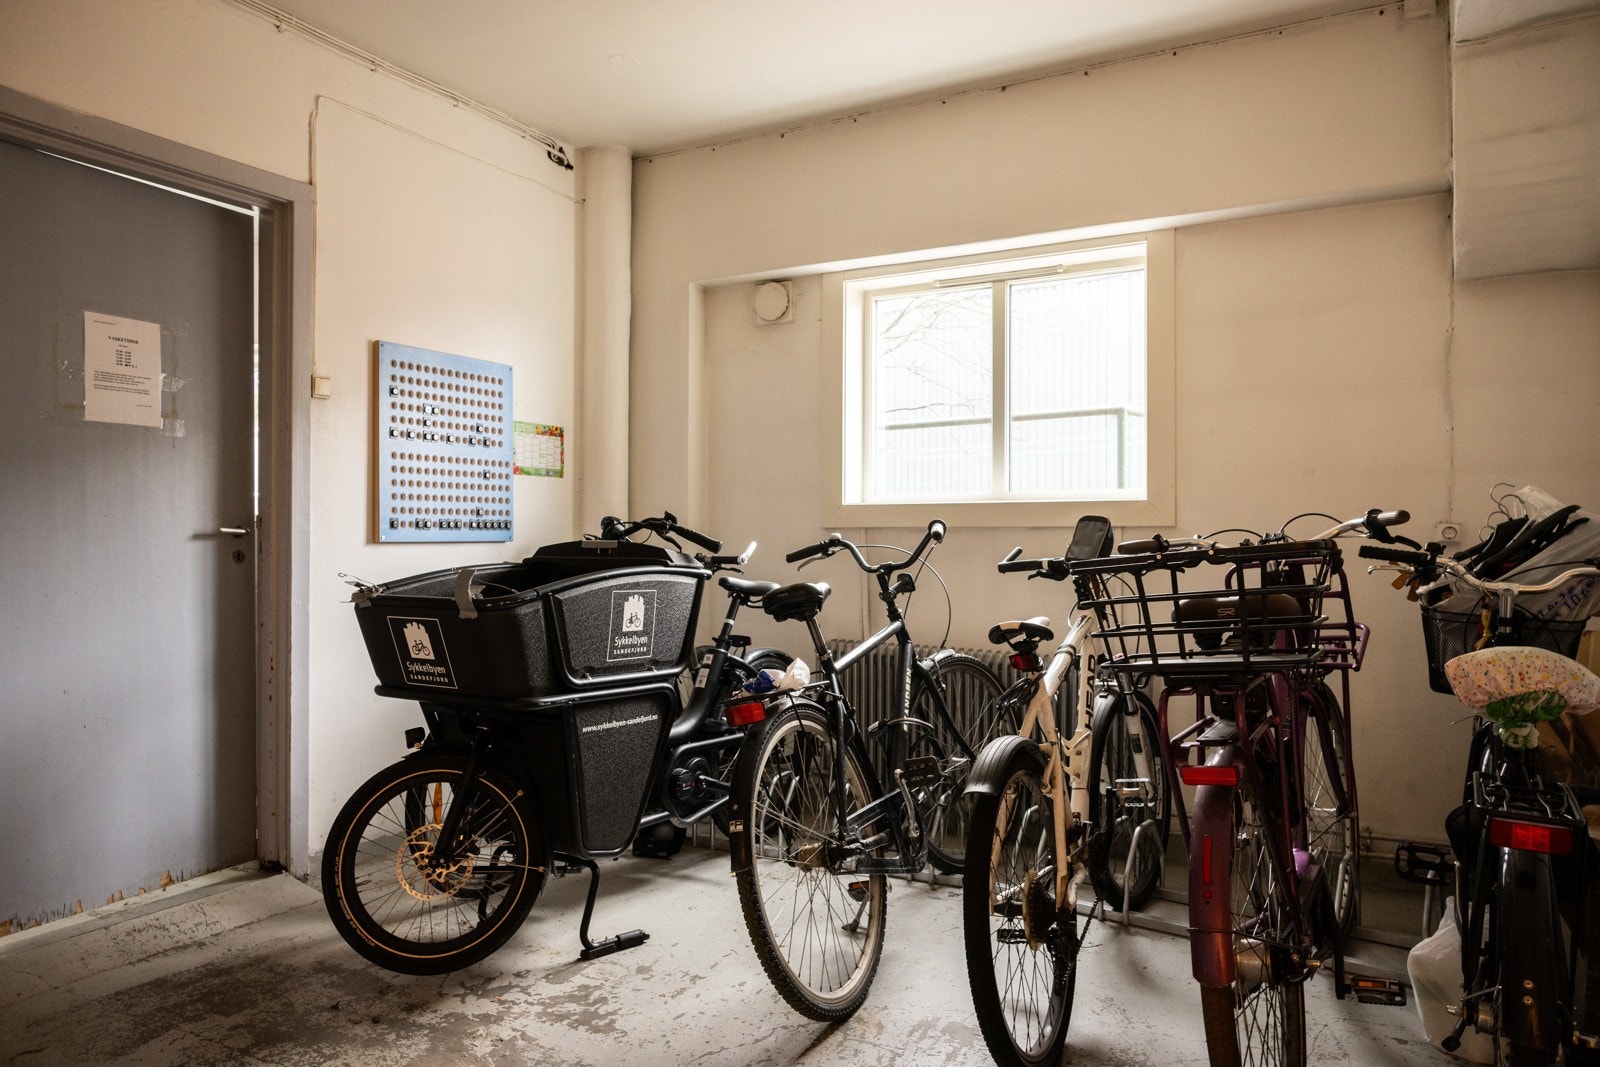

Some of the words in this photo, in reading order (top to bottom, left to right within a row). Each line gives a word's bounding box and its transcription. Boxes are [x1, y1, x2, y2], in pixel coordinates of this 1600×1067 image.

[614, 635, 648, 648] Sykkelbyen
[406, 661, 447, 676] Sykkelbyen
[1085, 654, 1096, 731] HEAD
